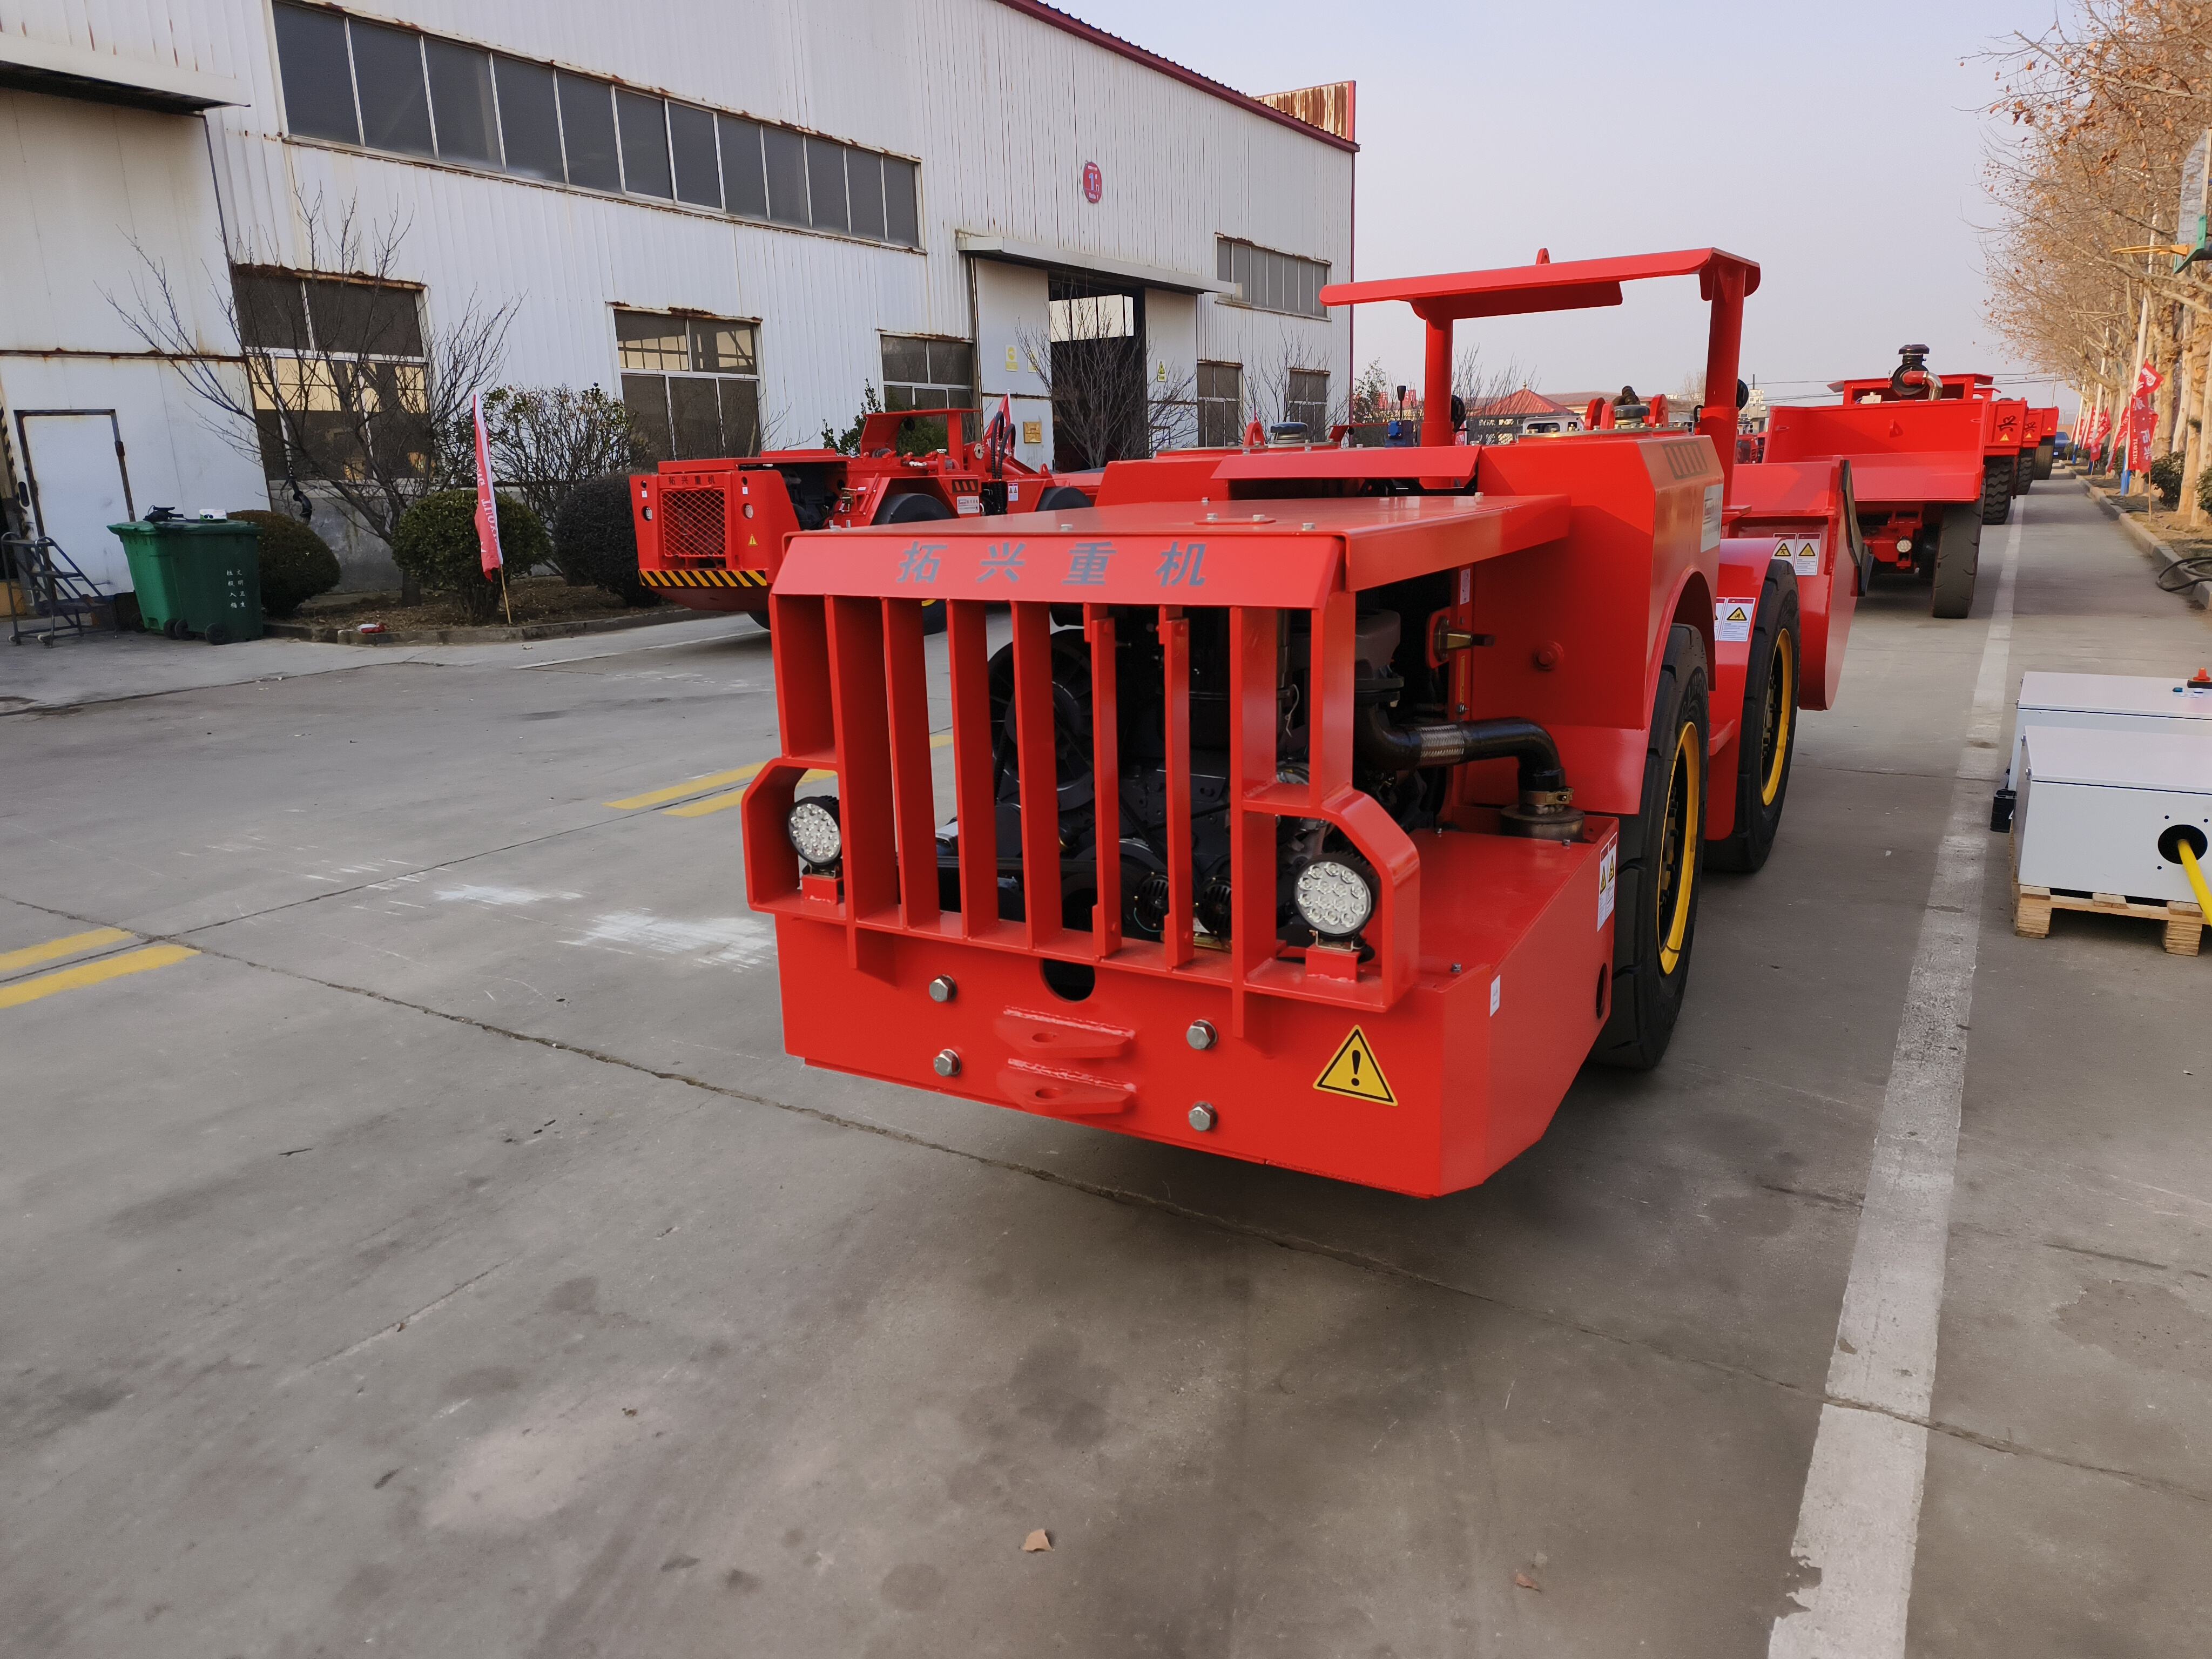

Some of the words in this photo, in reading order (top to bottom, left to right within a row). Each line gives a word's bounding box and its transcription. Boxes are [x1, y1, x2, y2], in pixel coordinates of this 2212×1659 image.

[1997, 415, 2018, 432] 兴
[896, 541, 1207, 587] 拓兴重机
